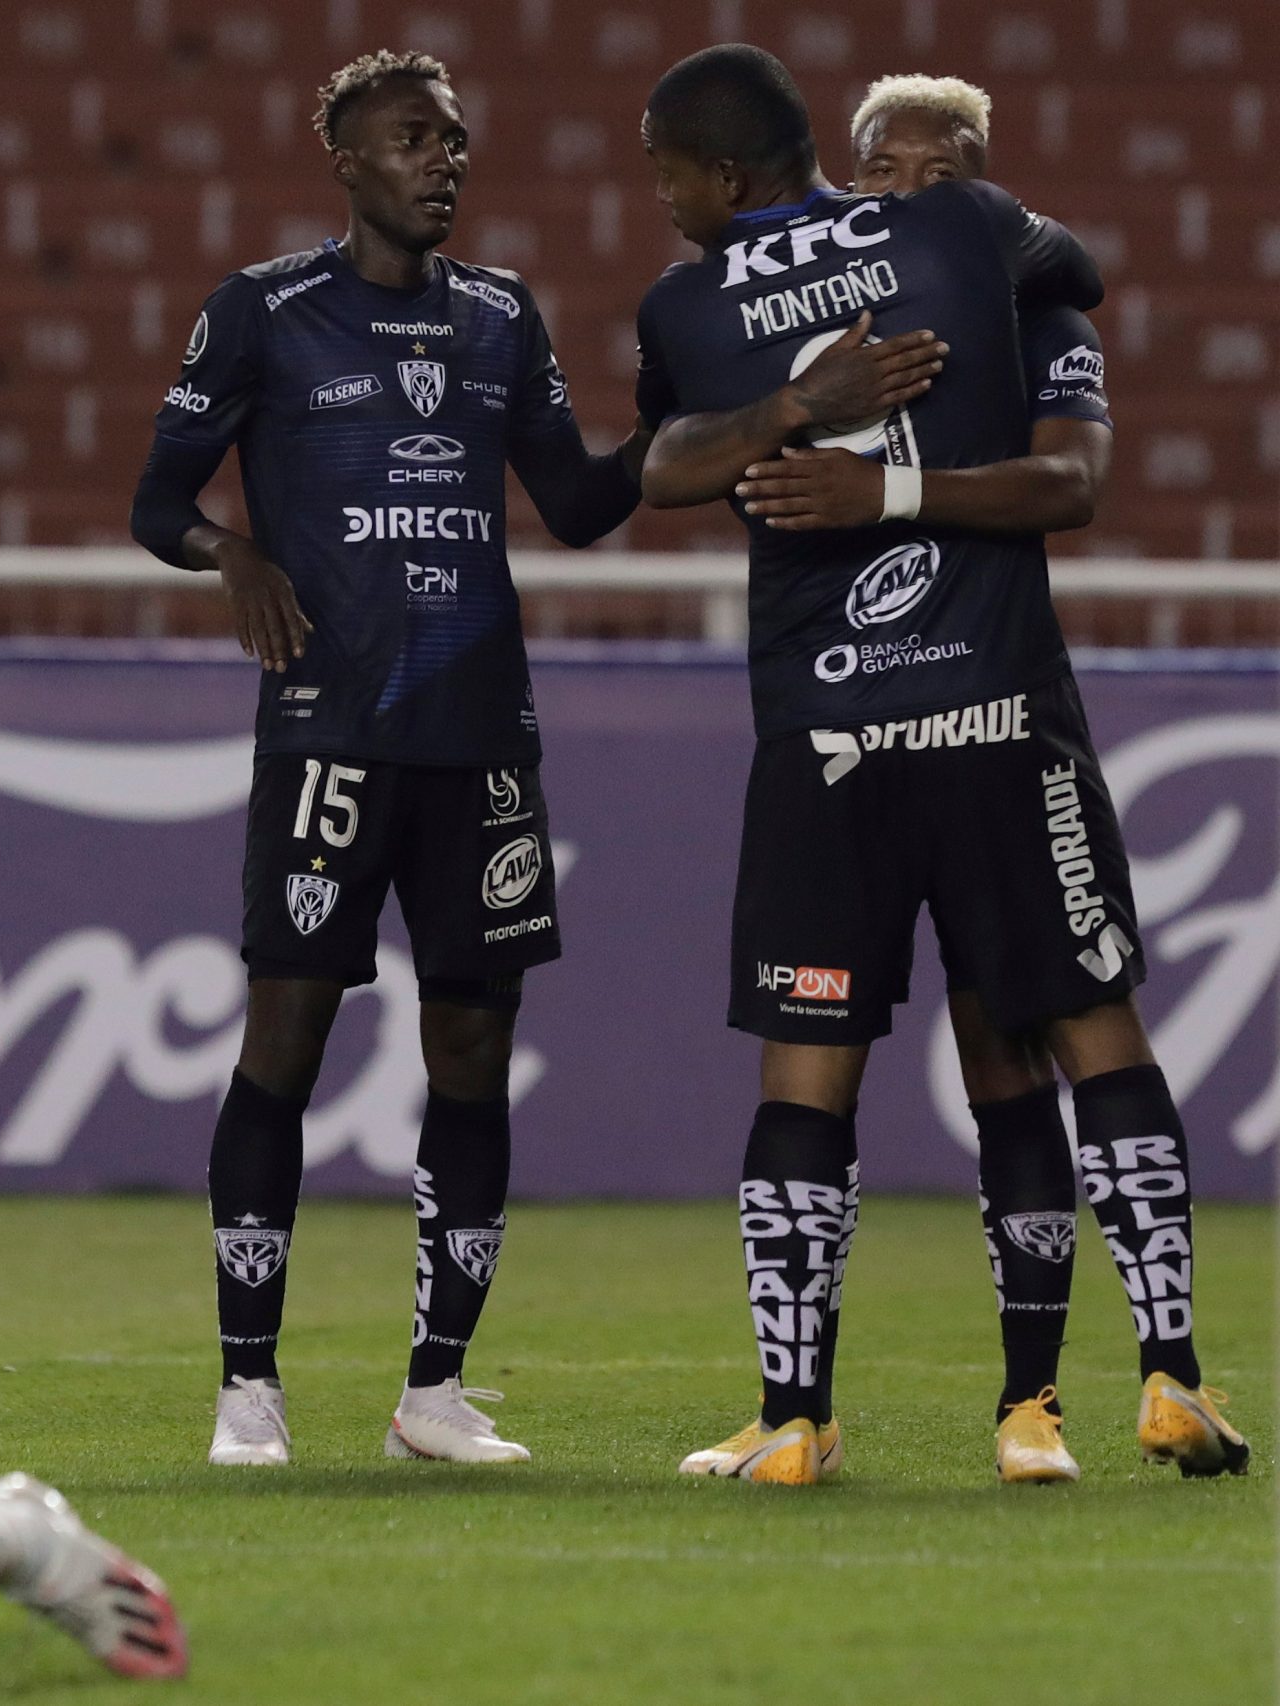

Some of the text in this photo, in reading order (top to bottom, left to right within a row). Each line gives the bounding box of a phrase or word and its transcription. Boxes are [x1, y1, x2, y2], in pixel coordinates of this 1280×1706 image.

[720, 201, 891, 289] KFC
[739, 258, 899, 340] MONTAÑO
[371, 321, 454, 337] marathon
[317, 378, 372, 406] PILSENER
[888, 424, 904, 464] LATAM
[388, 469, 467, 484] CHERY
[342, 506, 492, 543] DIRECTV
[852, 550, 936, 615] LAVA
[860, 633, 921, 660] BANCO
[862, 641, 974, 674] GUAYAQUIL
[293, 758, 367, 848] 15
[1041, 758, 1106, 937] SPORADE
[486, 846, 543, 895] LAVA
[484, 915, 552, 944] marathon
[756, 960, 849, 999] JAPON
